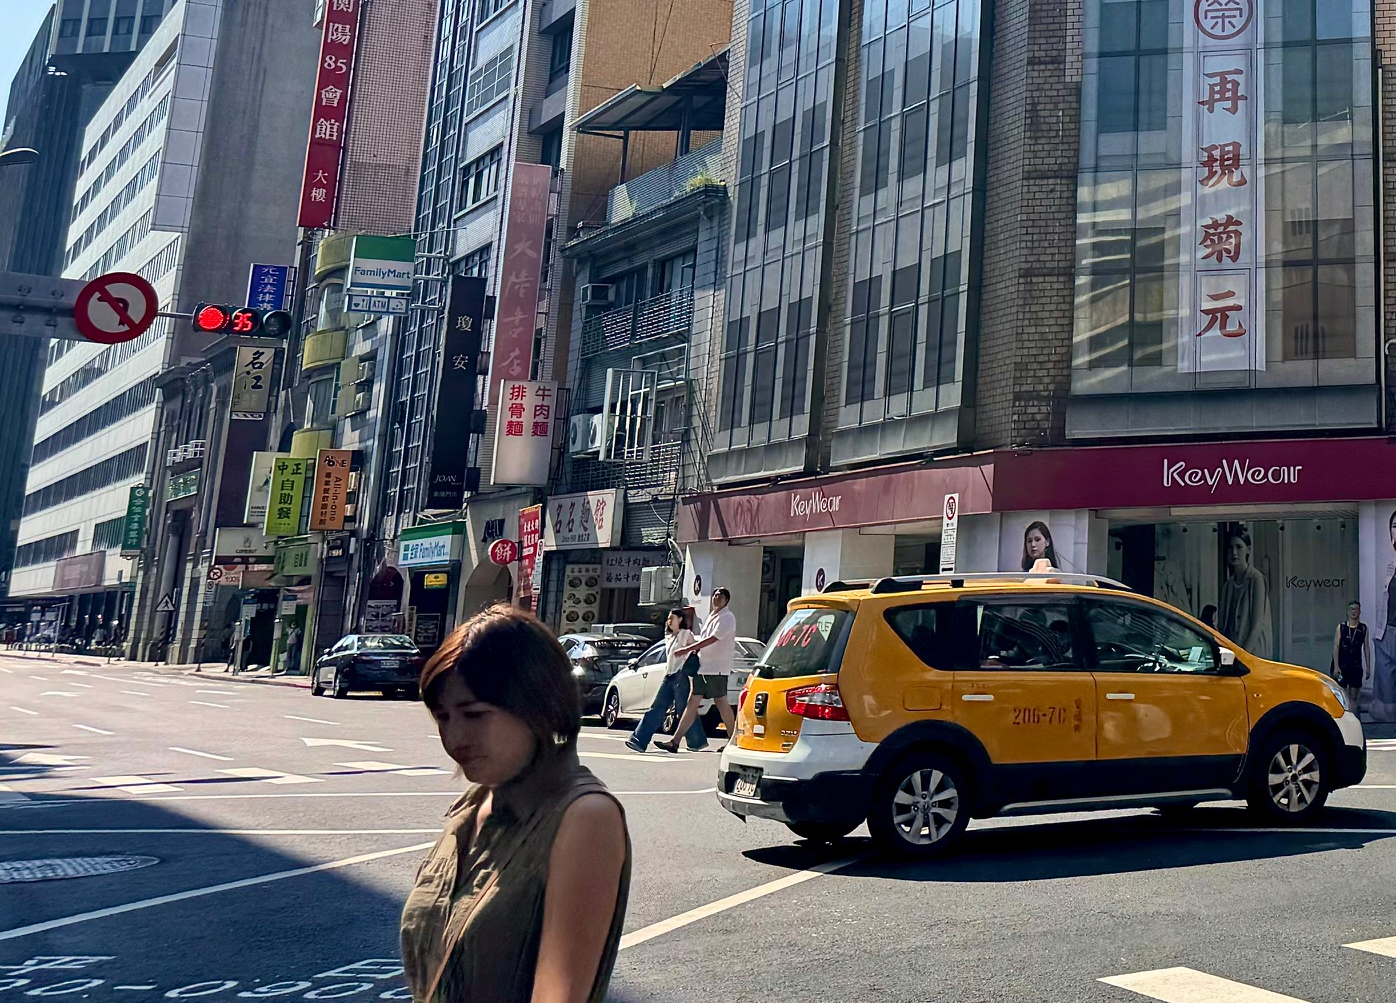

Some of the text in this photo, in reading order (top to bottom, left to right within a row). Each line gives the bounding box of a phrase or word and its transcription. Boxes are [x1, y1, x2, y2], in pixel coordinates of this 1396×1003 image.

[310, 168, 329, 203] 大樓
[354, 266, 411, 280] FamilyMart
[372, 299, 388, 312] ATM
[231, 312, 254, 332] 35
[452, 315, 473, 370] 瓊安
[505, 384, 527, 437] 排骨麵
[531, 385, 552, 437] 牛肉麵
[277, 461, 303, 476] 中正
[434, 474, 457, 483] JOAN
[1162, 458, 1302, 494] KeyWear
[276, 479, 295, 520] 自助餐
[790, 492, 842, 521] KeyWear
[420, 540, 446, 560] FamilyMart
[495, 542, 512, 561] 餅
[1285, 575, 1346, 590] Keywear
[1012, 706, 1067, 726] 206-7C
